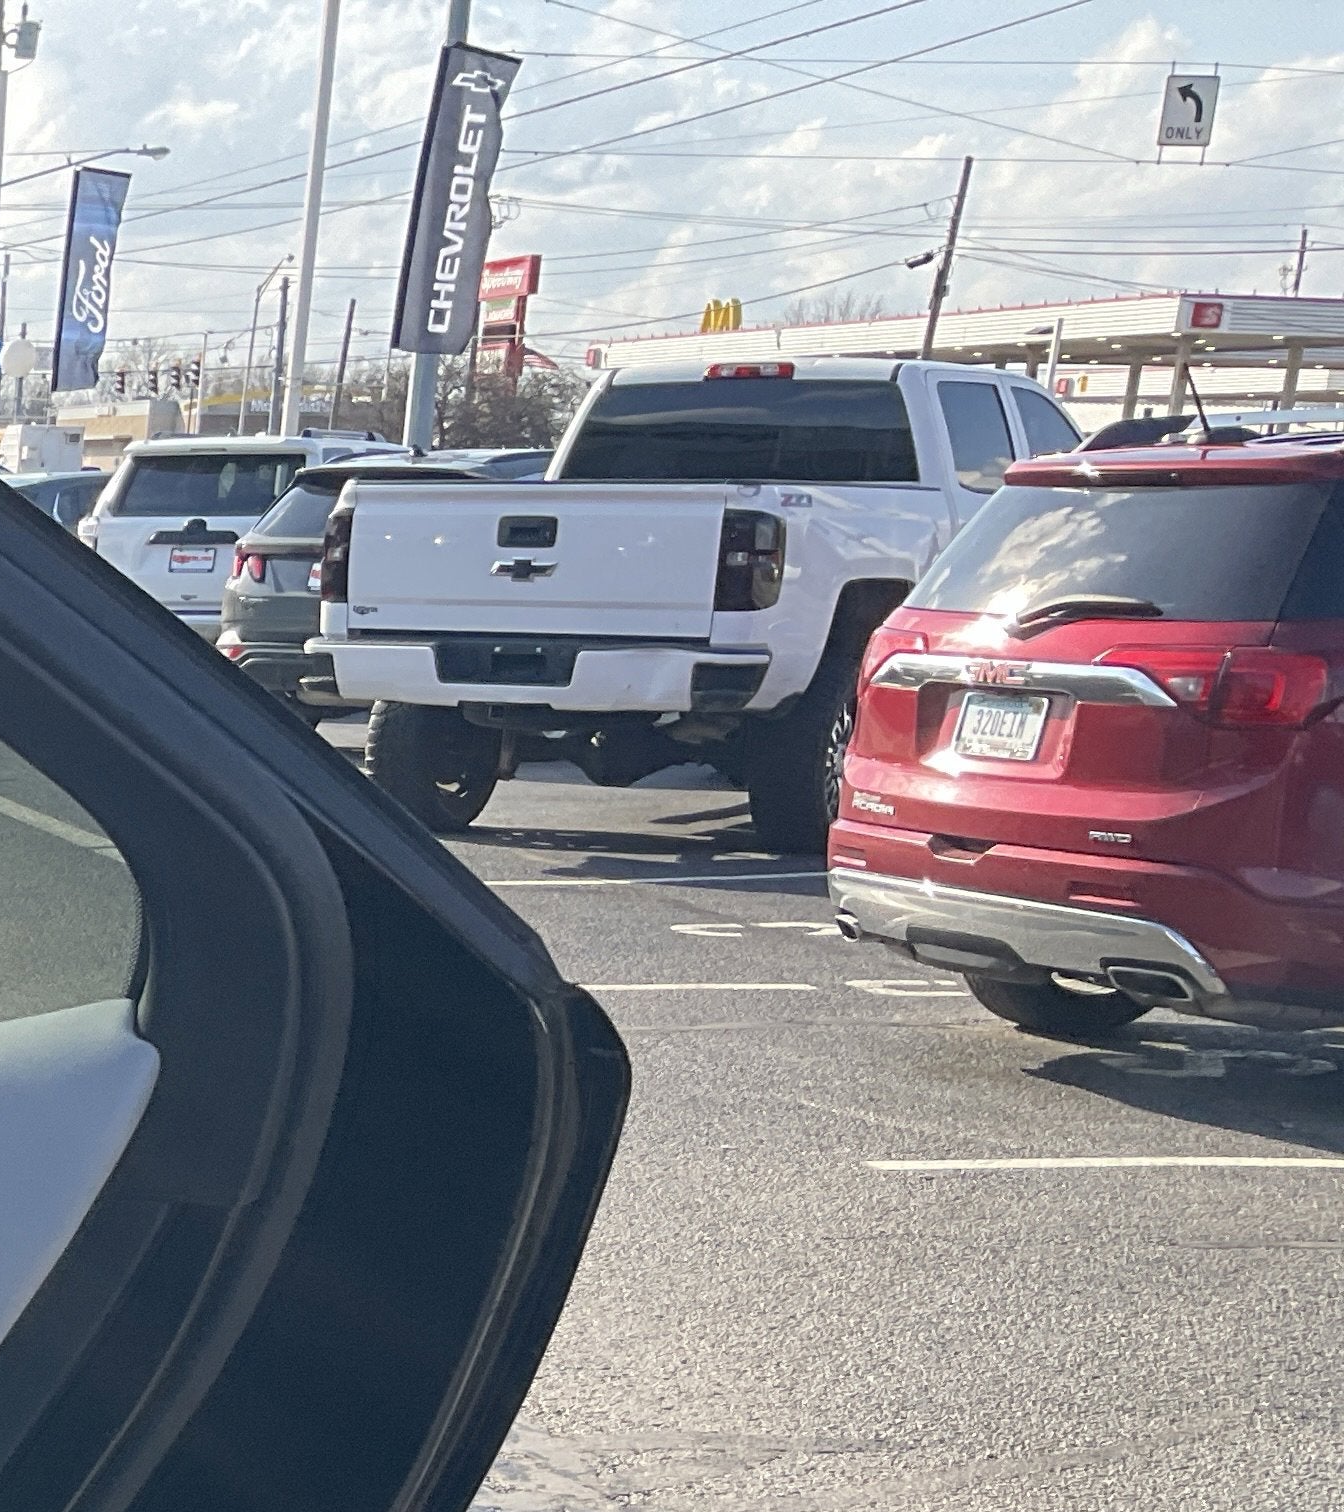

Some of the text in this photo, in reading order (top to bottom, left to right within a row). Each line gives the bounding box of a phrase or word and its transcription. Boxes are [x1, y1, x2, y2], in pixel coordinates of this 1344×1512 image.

[1165, 126, 1204, 140] ONLY
[427, 104, 487, 334] CHEVROLET
[72, 235, 110, 333] Ford
